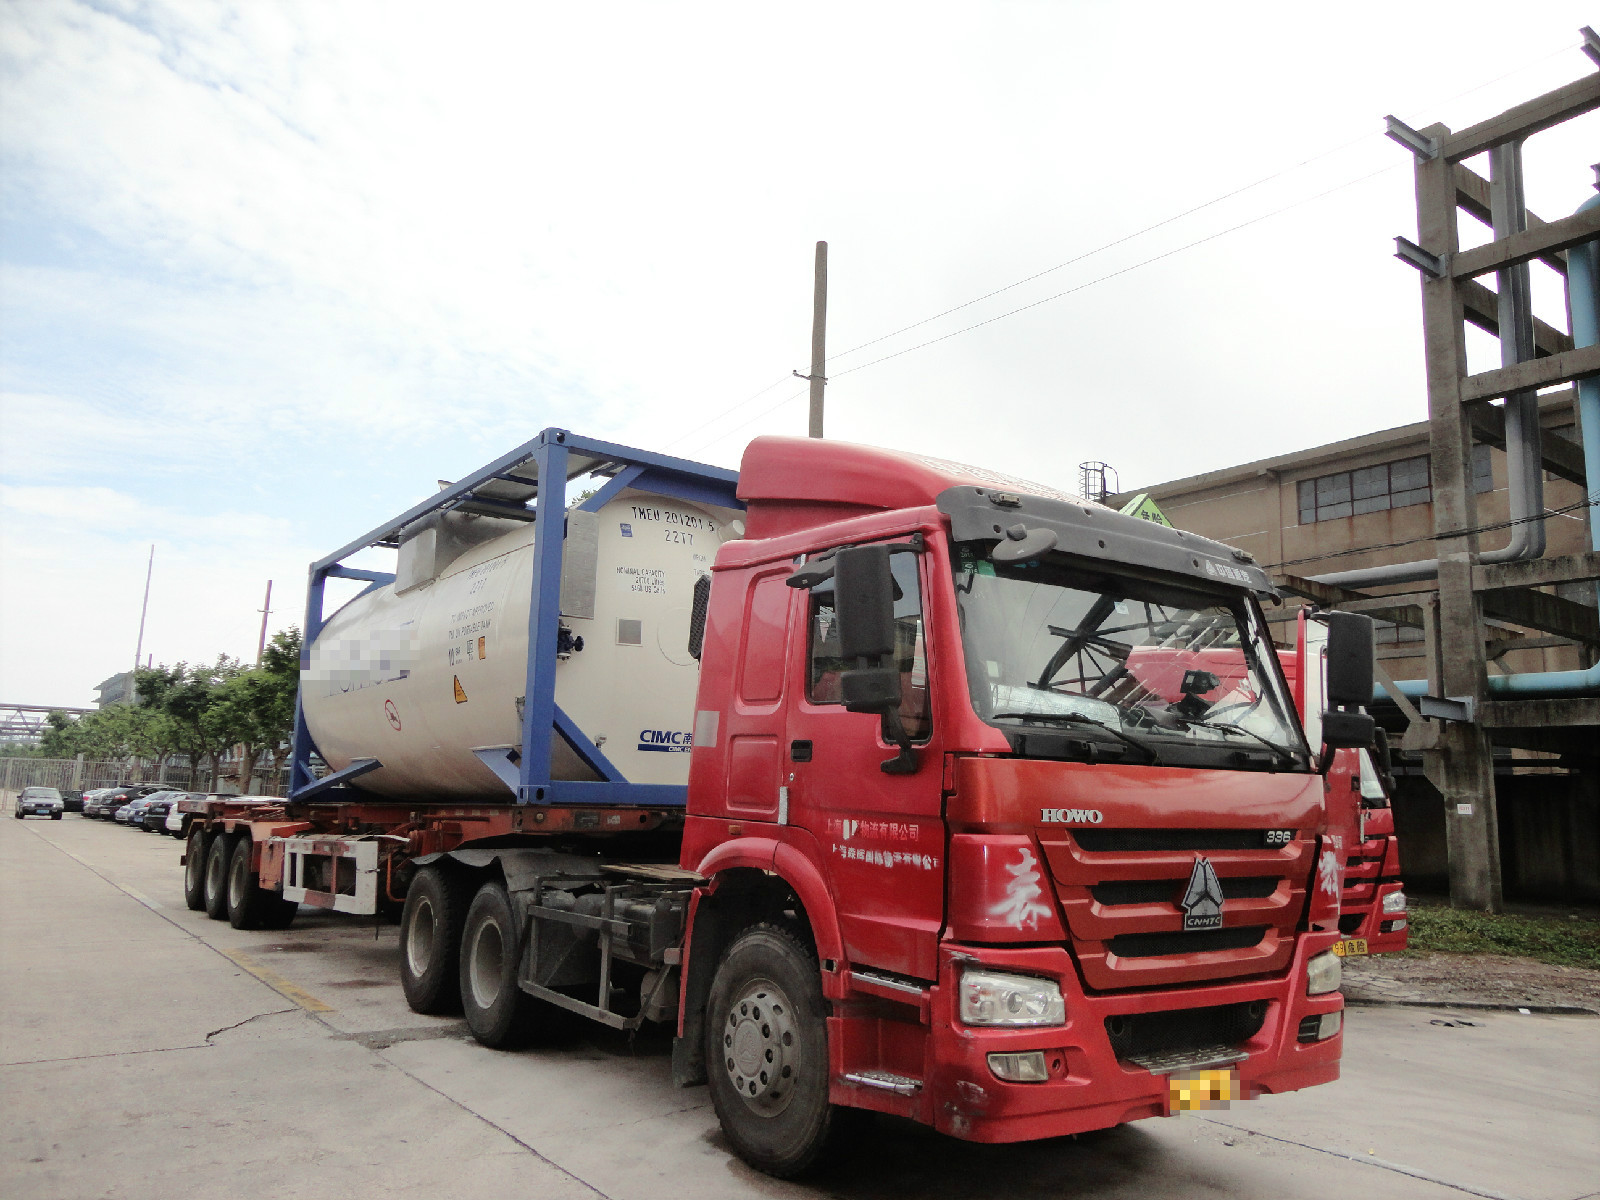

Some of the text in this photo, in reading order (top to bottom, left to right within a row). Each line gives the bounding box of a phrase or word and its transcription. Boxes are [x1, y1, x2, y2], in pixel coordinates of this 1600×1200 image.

[632, 507, 715, 532] TMEU 201201 5
[640, 730, 682, 744] CIMC
[1040, 809, 1103, 823] HOWO
[826, 819, 919, 842] 上海物流有限公司
[1267, 831, 1291, 843] 336
[1188, 917, 1221, 926] CNHTC
